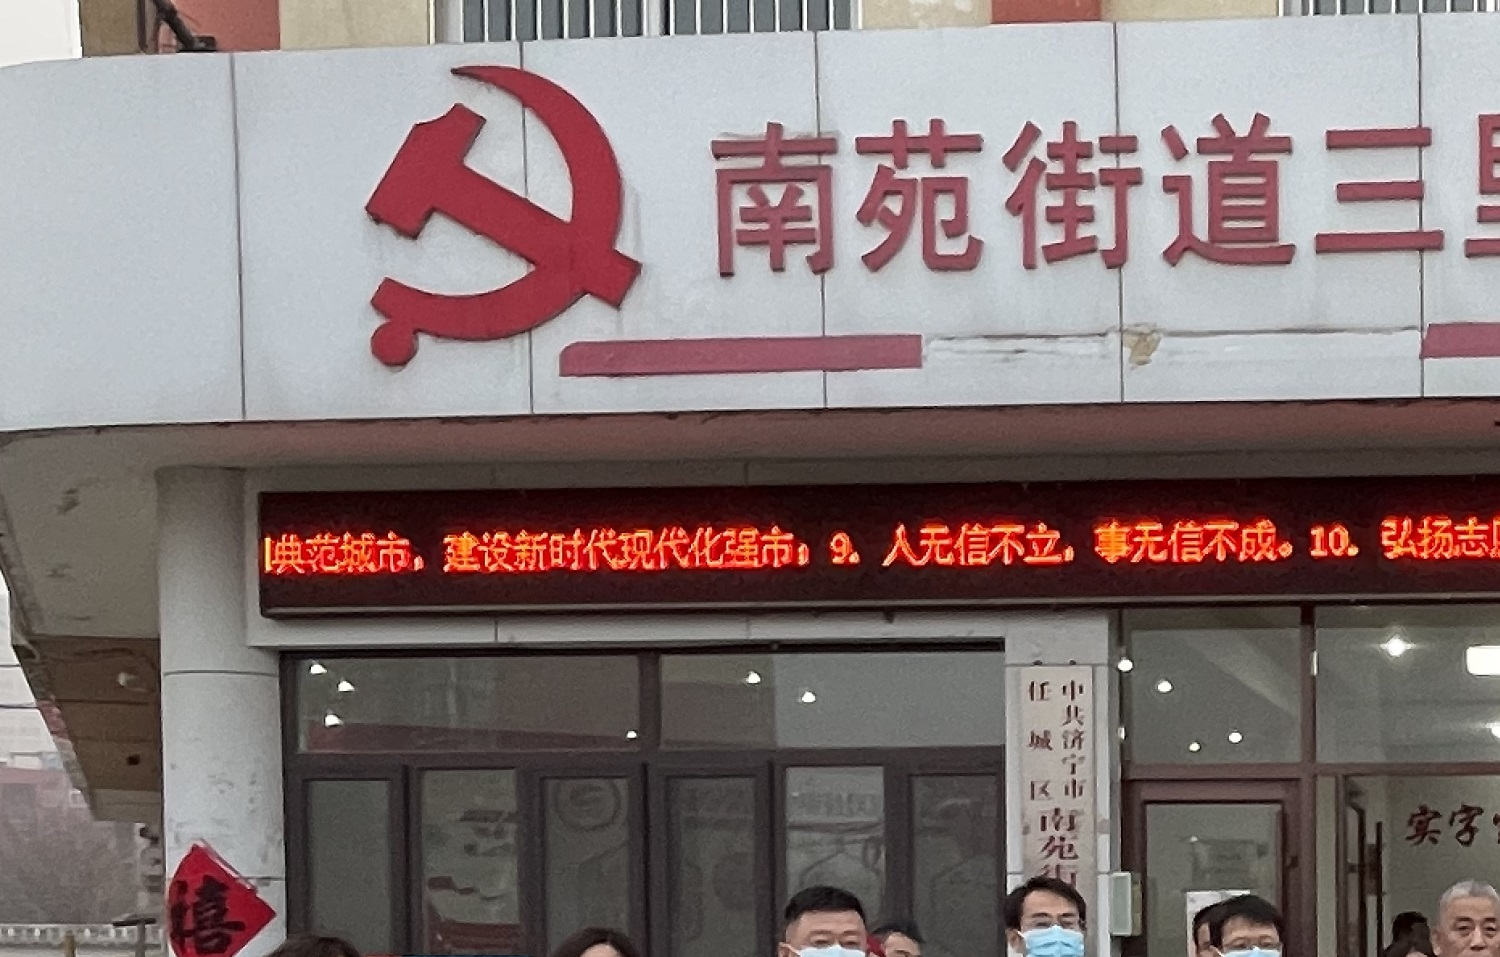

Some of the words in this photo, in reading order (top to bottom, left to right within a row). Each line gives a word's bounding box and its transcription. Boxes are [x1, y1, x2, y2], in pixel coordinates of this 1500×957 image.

[264, 532, 424, 574] 典范城市，
[1028, 680, 1053, 801] 任城区
[1062, 680, 1085, 800] 中共济宁市
